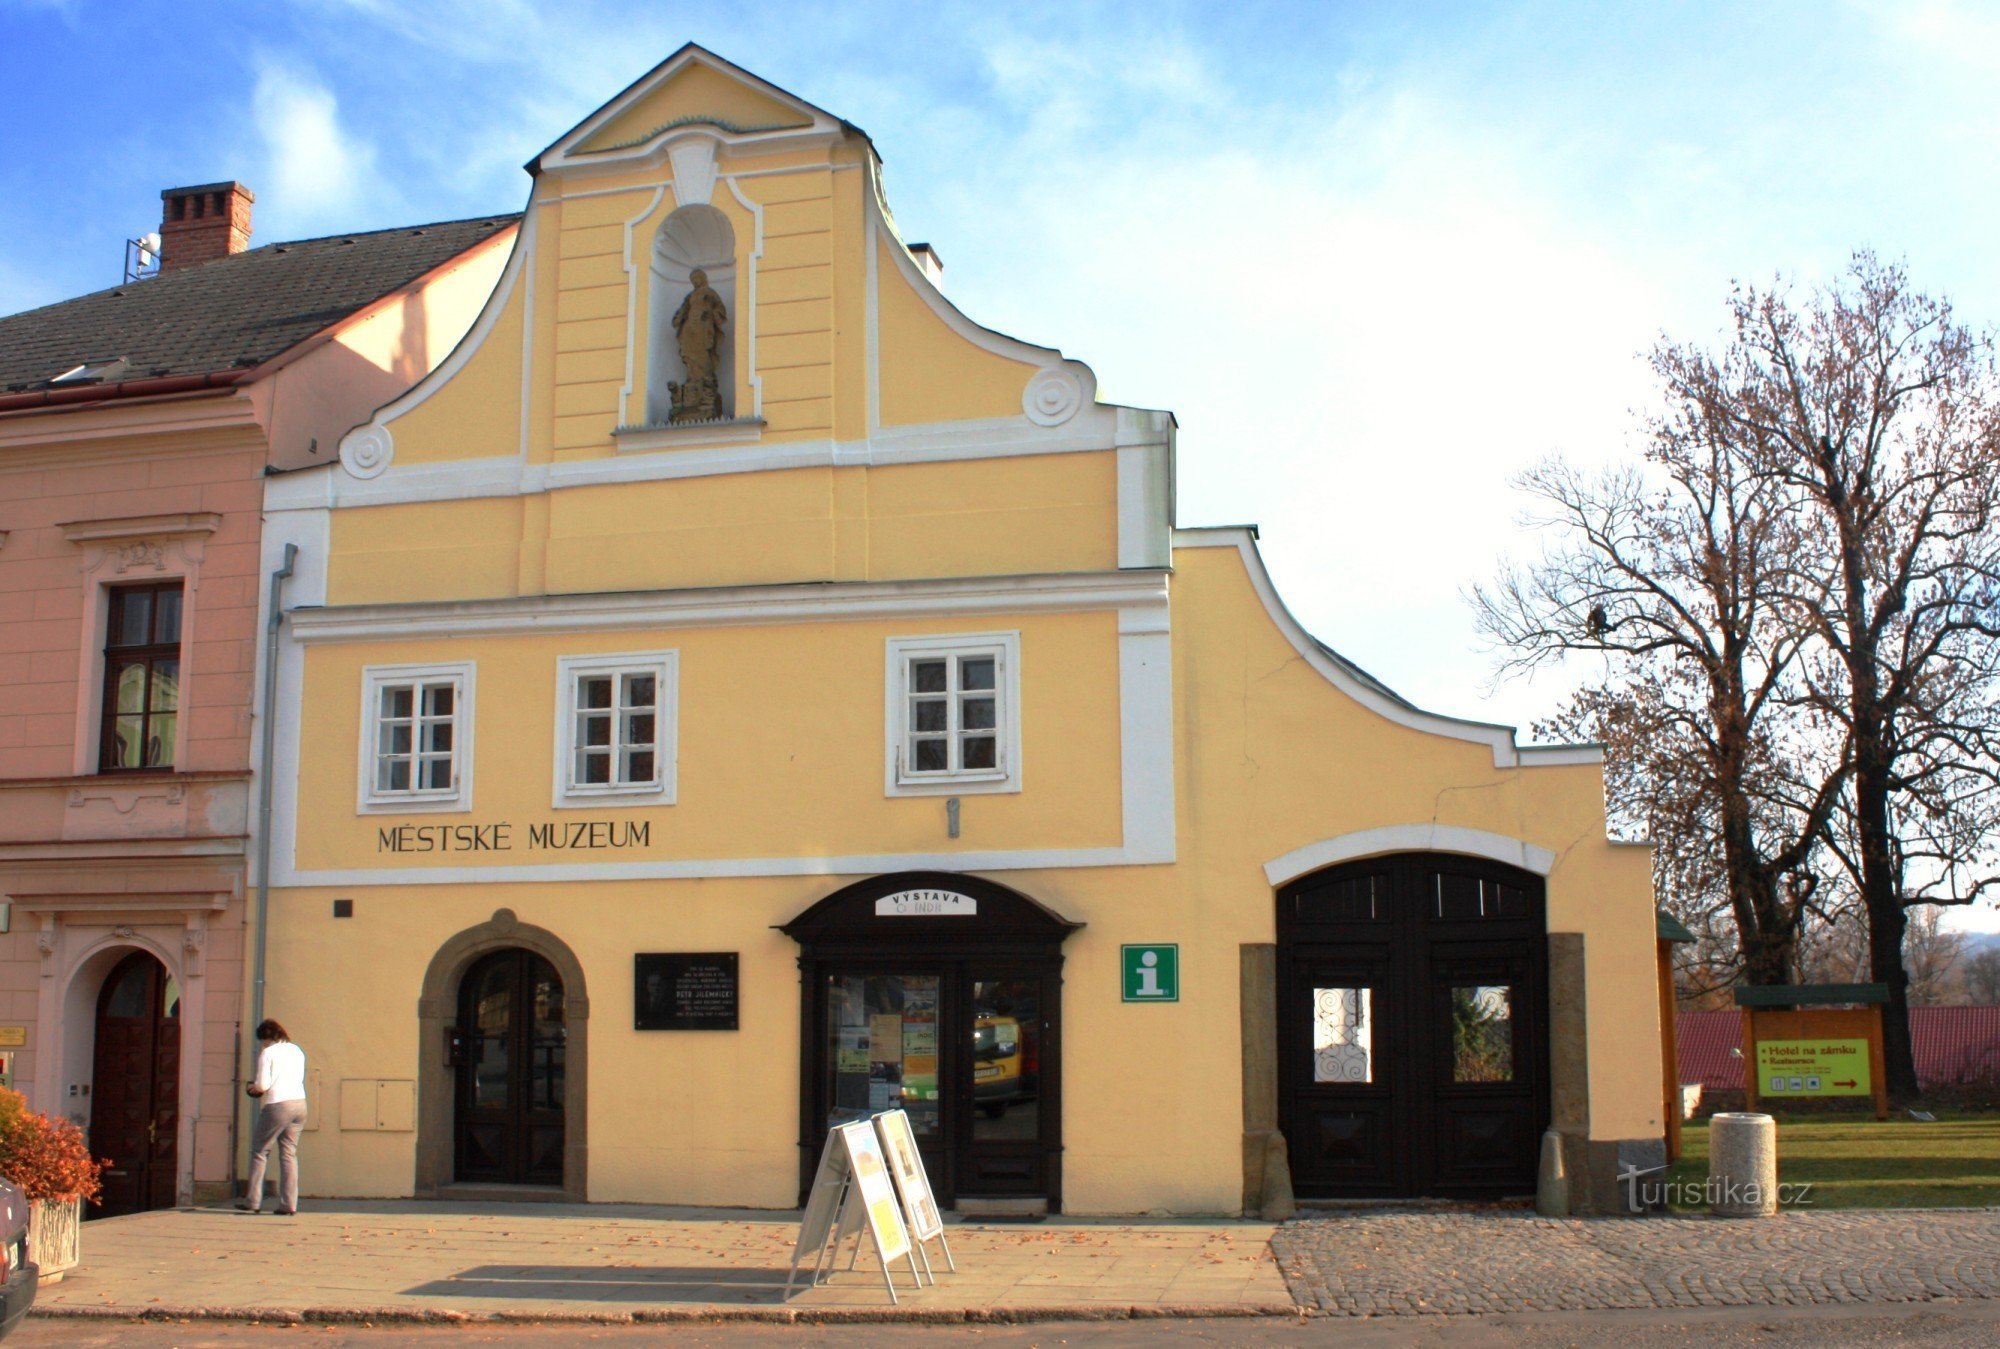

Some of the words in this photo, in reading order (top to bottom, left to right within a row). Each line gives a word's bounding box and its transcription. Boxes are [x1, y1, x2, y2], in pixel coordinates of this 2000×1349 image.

[528, 820, 650, 850] MUZEUM
[892, 891, 960, 904] VÝSTAVA
[676, 990, 692, 998] PETR
[1769, 1046, 1799, 1055] Hotel
